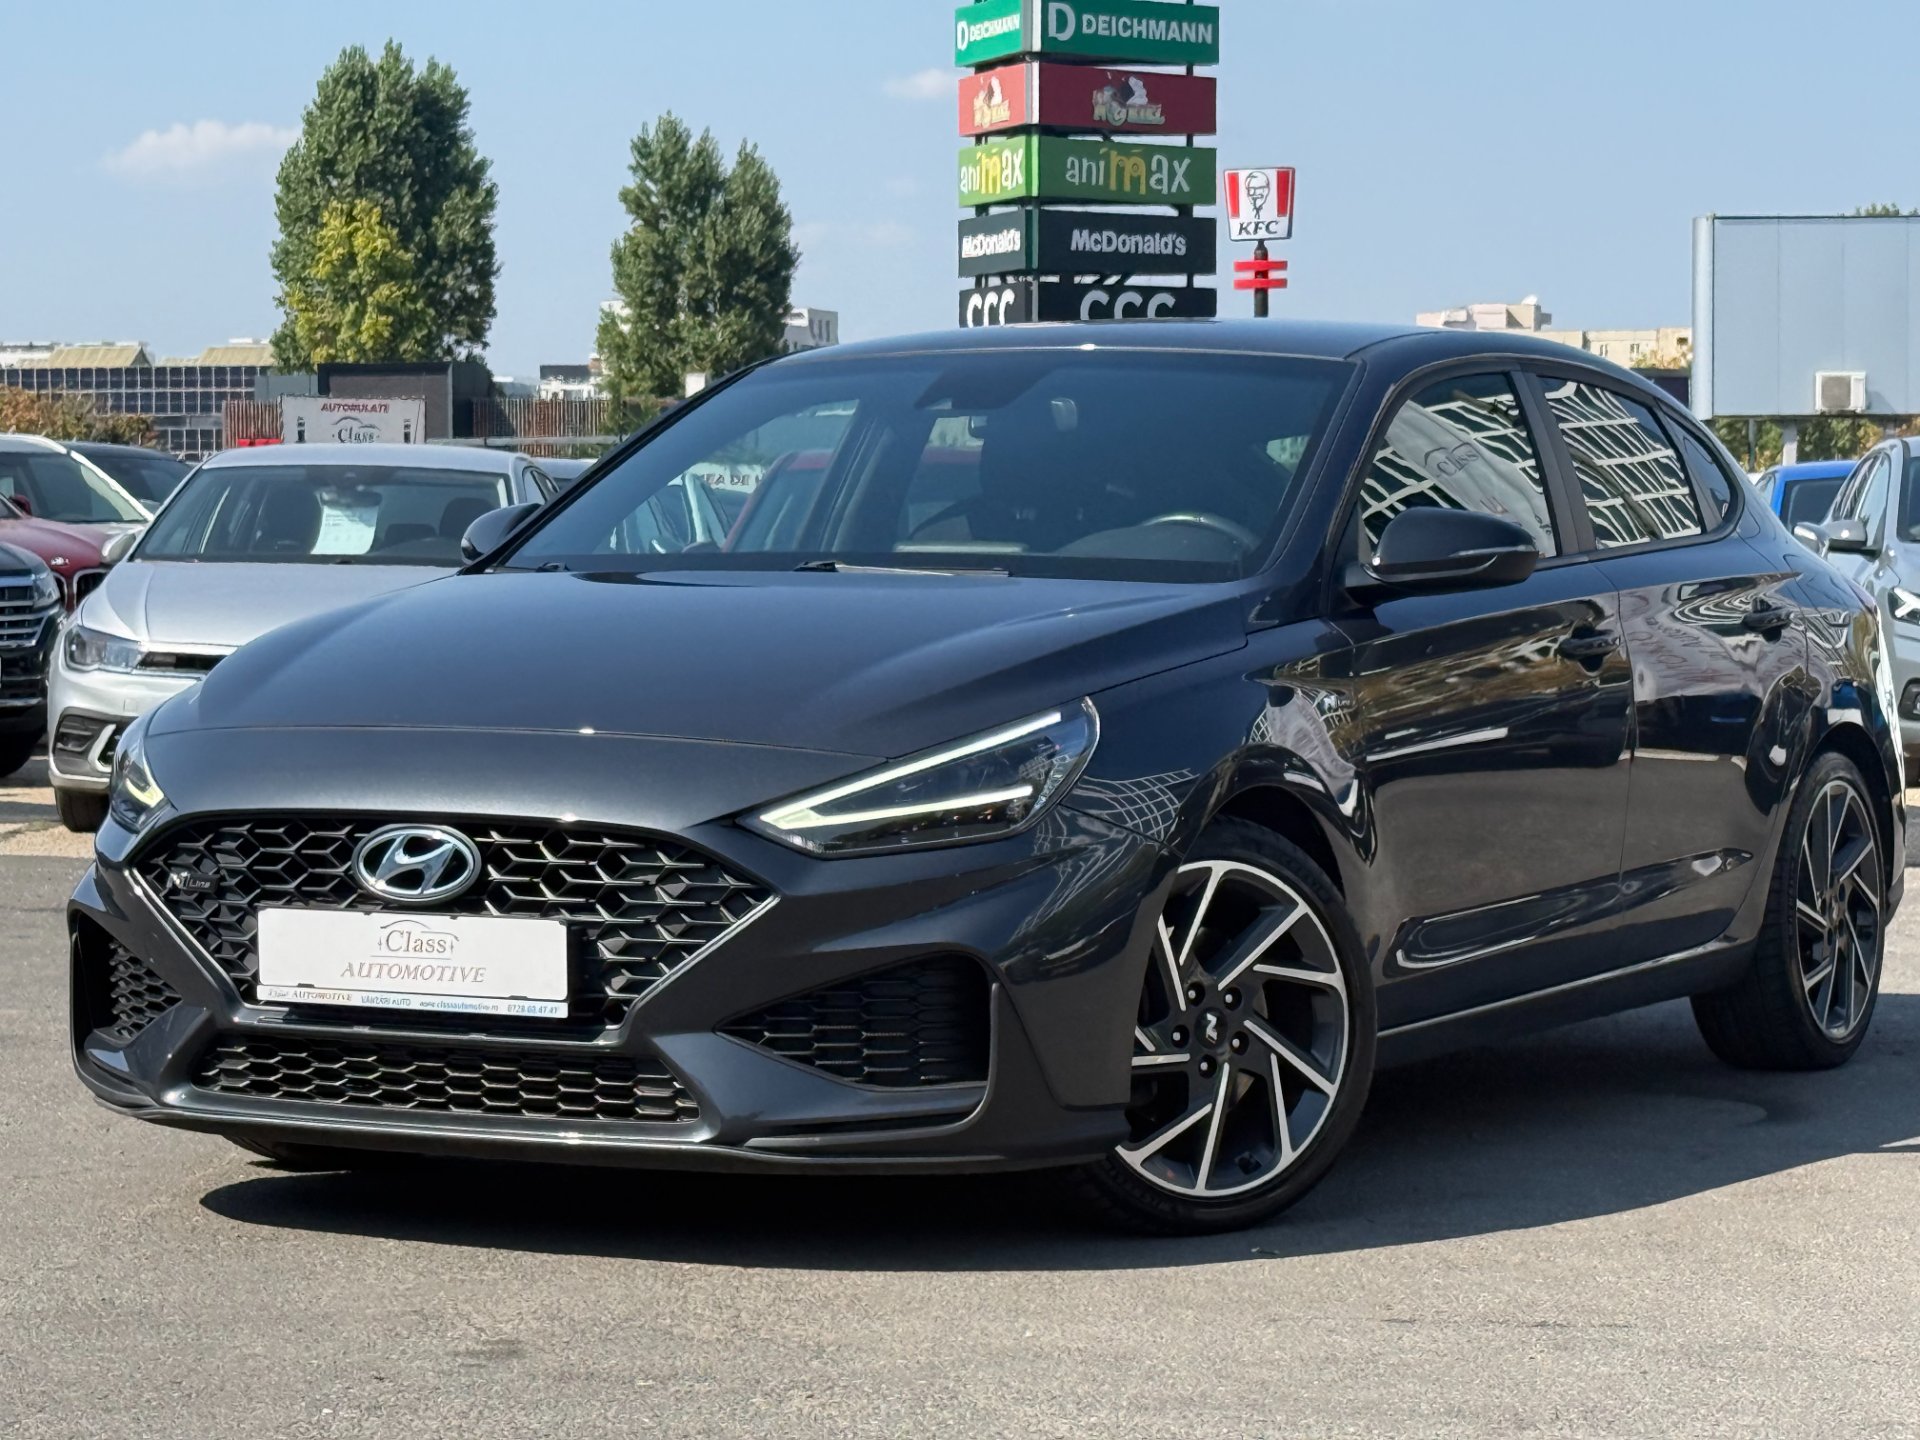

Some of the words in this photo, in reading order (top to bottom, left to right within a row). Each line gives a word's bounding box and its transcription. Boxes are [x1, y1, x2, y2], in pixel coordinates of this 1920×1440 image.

[970, 13, 1020, 42] DEICHMANN
[1082, 13, 1213, 45] DEICHMANN
[1066, 147, 1191, 195] animax
[1238, 220, 1279, 235] KFC
[1070, 228, 1187, 256] McDonald's
[386, 929, 447, 954] Class
[340, 962, 487, 983] AUTOMOTIVE
[292, 990, 353, 1001] AUTOMOTIVE
